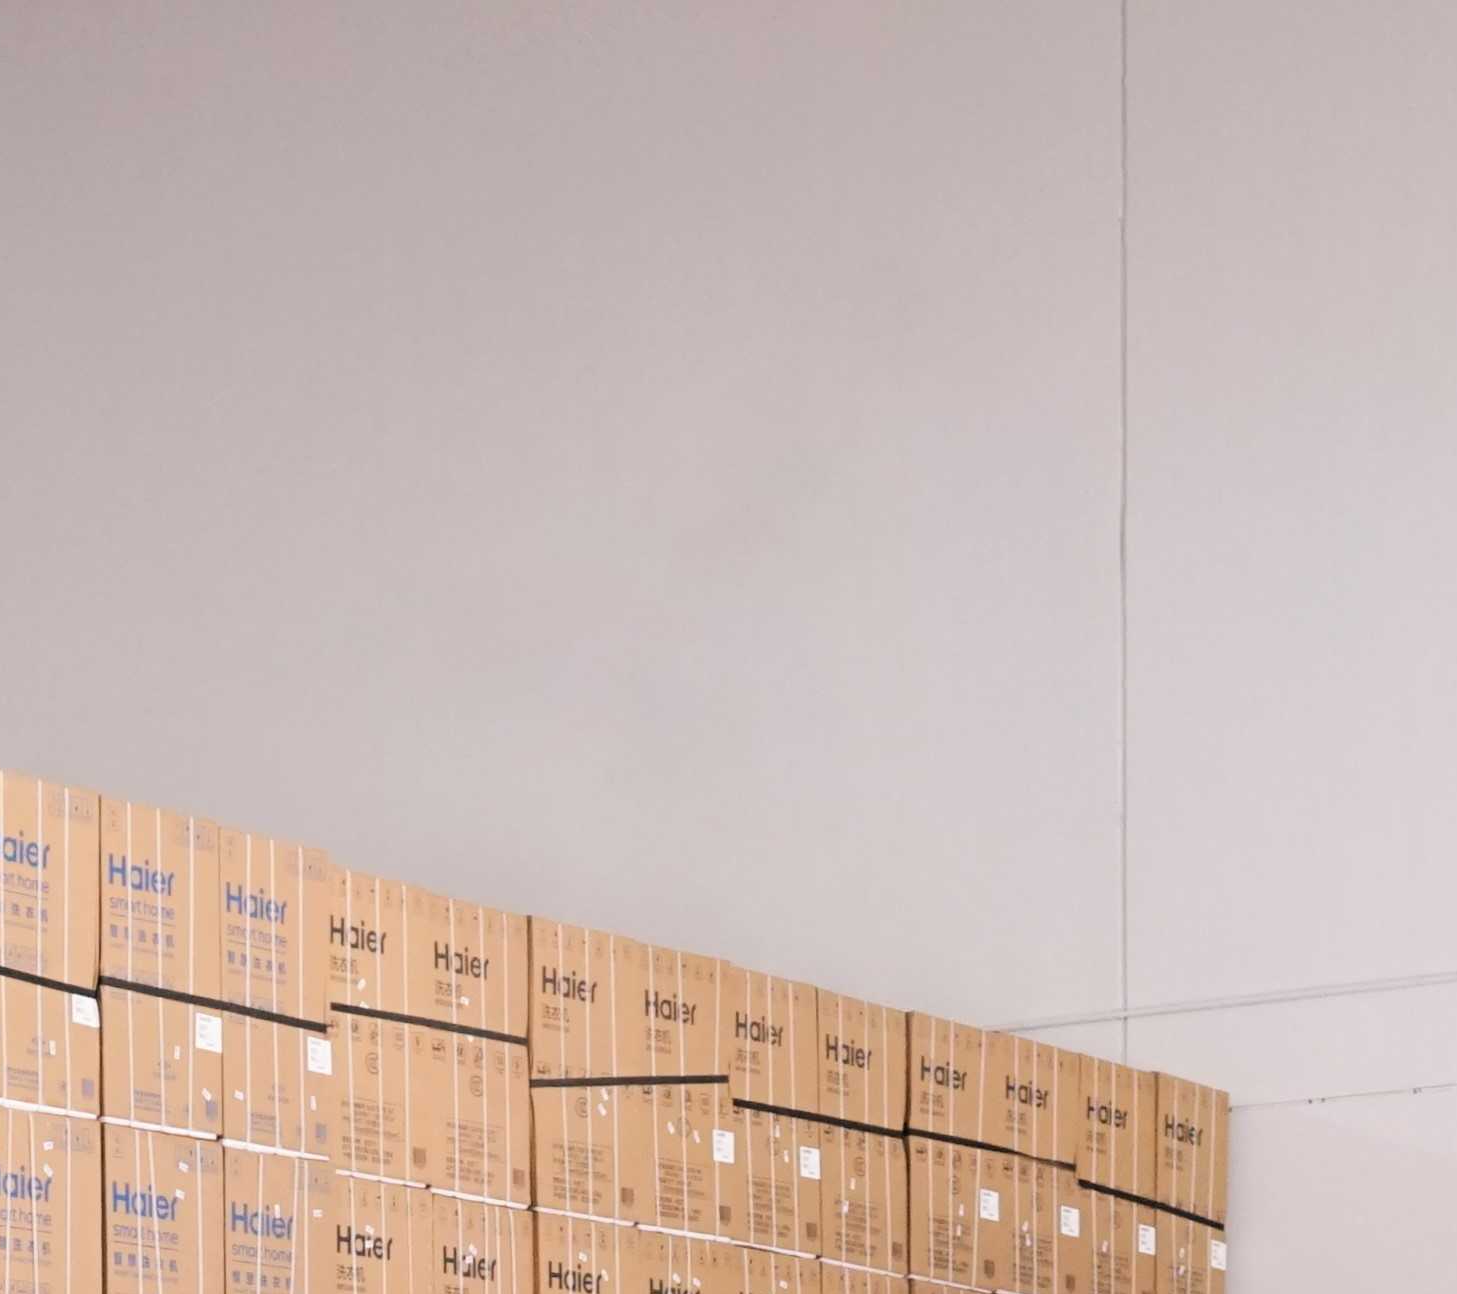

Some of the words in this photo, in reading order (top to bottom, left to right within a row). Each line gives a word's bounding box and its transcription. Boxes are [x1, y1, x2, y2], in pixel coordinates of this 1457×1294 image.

[108, 853, 174, 896] Haier
[227, 882, 286, 924] Haier
[330, 915, 386, 954] Haier
[434, 941, 489, 981] Haier
[542, 966, 597, 1003] Haier
[645, 989, 697, 1025] Haier
[735, 1011, 784, 1047] Haier
[826, 1034, 872, 1071] Haier
[920, 1055, 967, 1092] Haier
[1005, 1075, 1047, 1110] Haier
[1087, 1096, 1127, 1130] Haier
[1164, 1113, 1202, 1147] Haier
[112, 1181, 178, 1221] Haier
[231, 1202, 293, 1240] Haier
